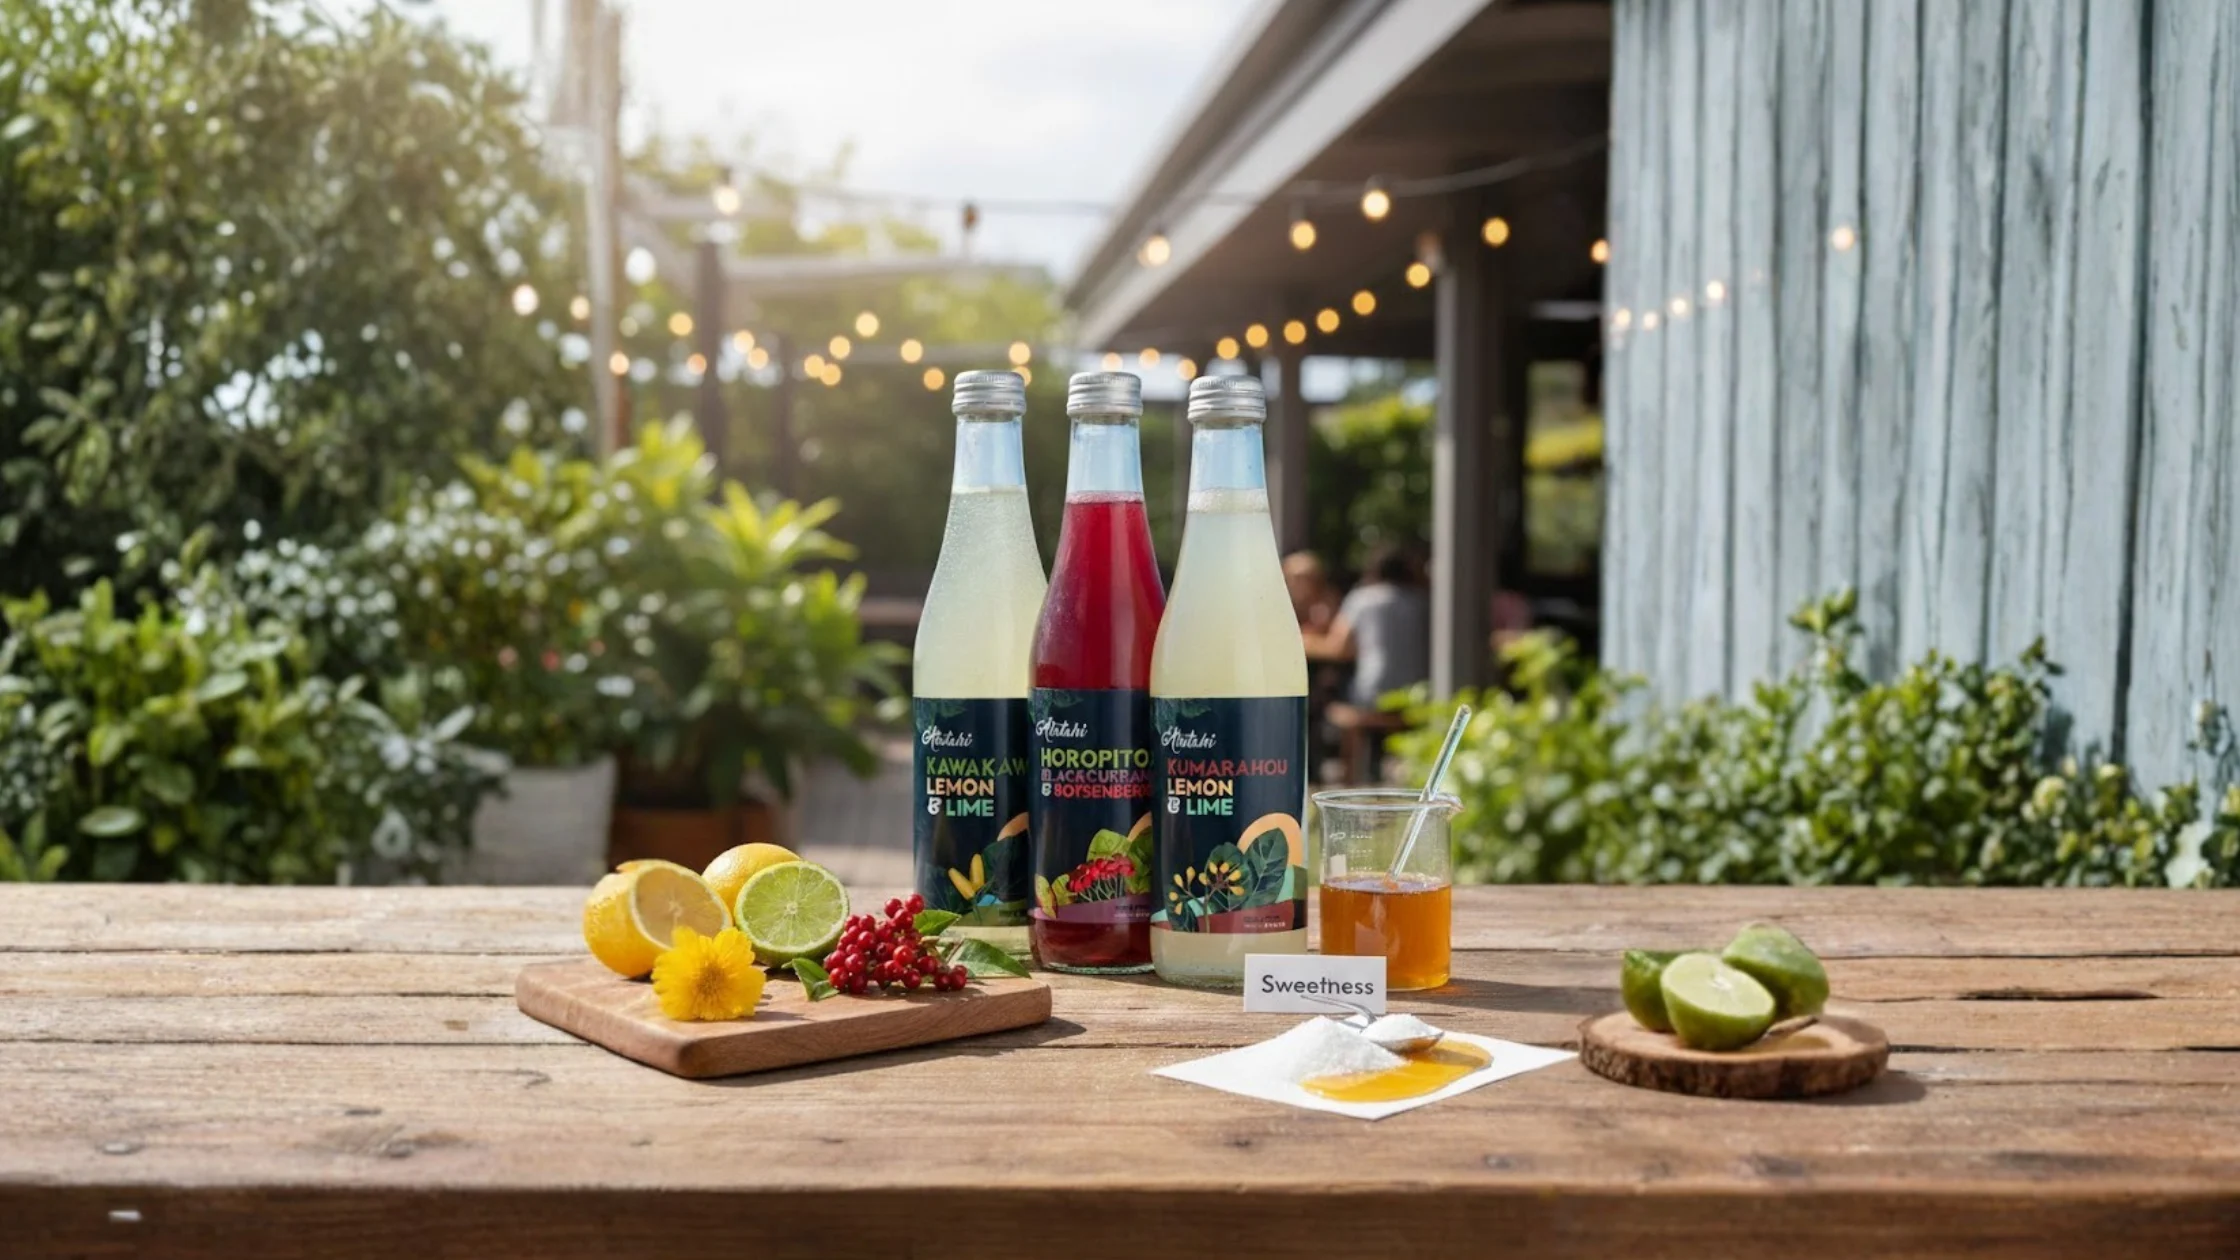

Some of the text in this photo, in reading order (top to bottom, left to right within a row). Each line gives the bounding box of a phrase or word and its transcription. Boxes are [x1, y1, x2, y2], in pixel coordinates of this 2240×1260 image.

[1040, 747, 1149, 768] HOROPITO
[1167, 758, 1288, 776] KUMARAHOU
[926, 777, 995, 796] LEMON
[1167, 777, 1234, 797] LEMON
[945, 799, 995, 816] LIME
[1186, 798, 1234, 816] LIME
[1262, 974, 1374, 995] Sweetness
